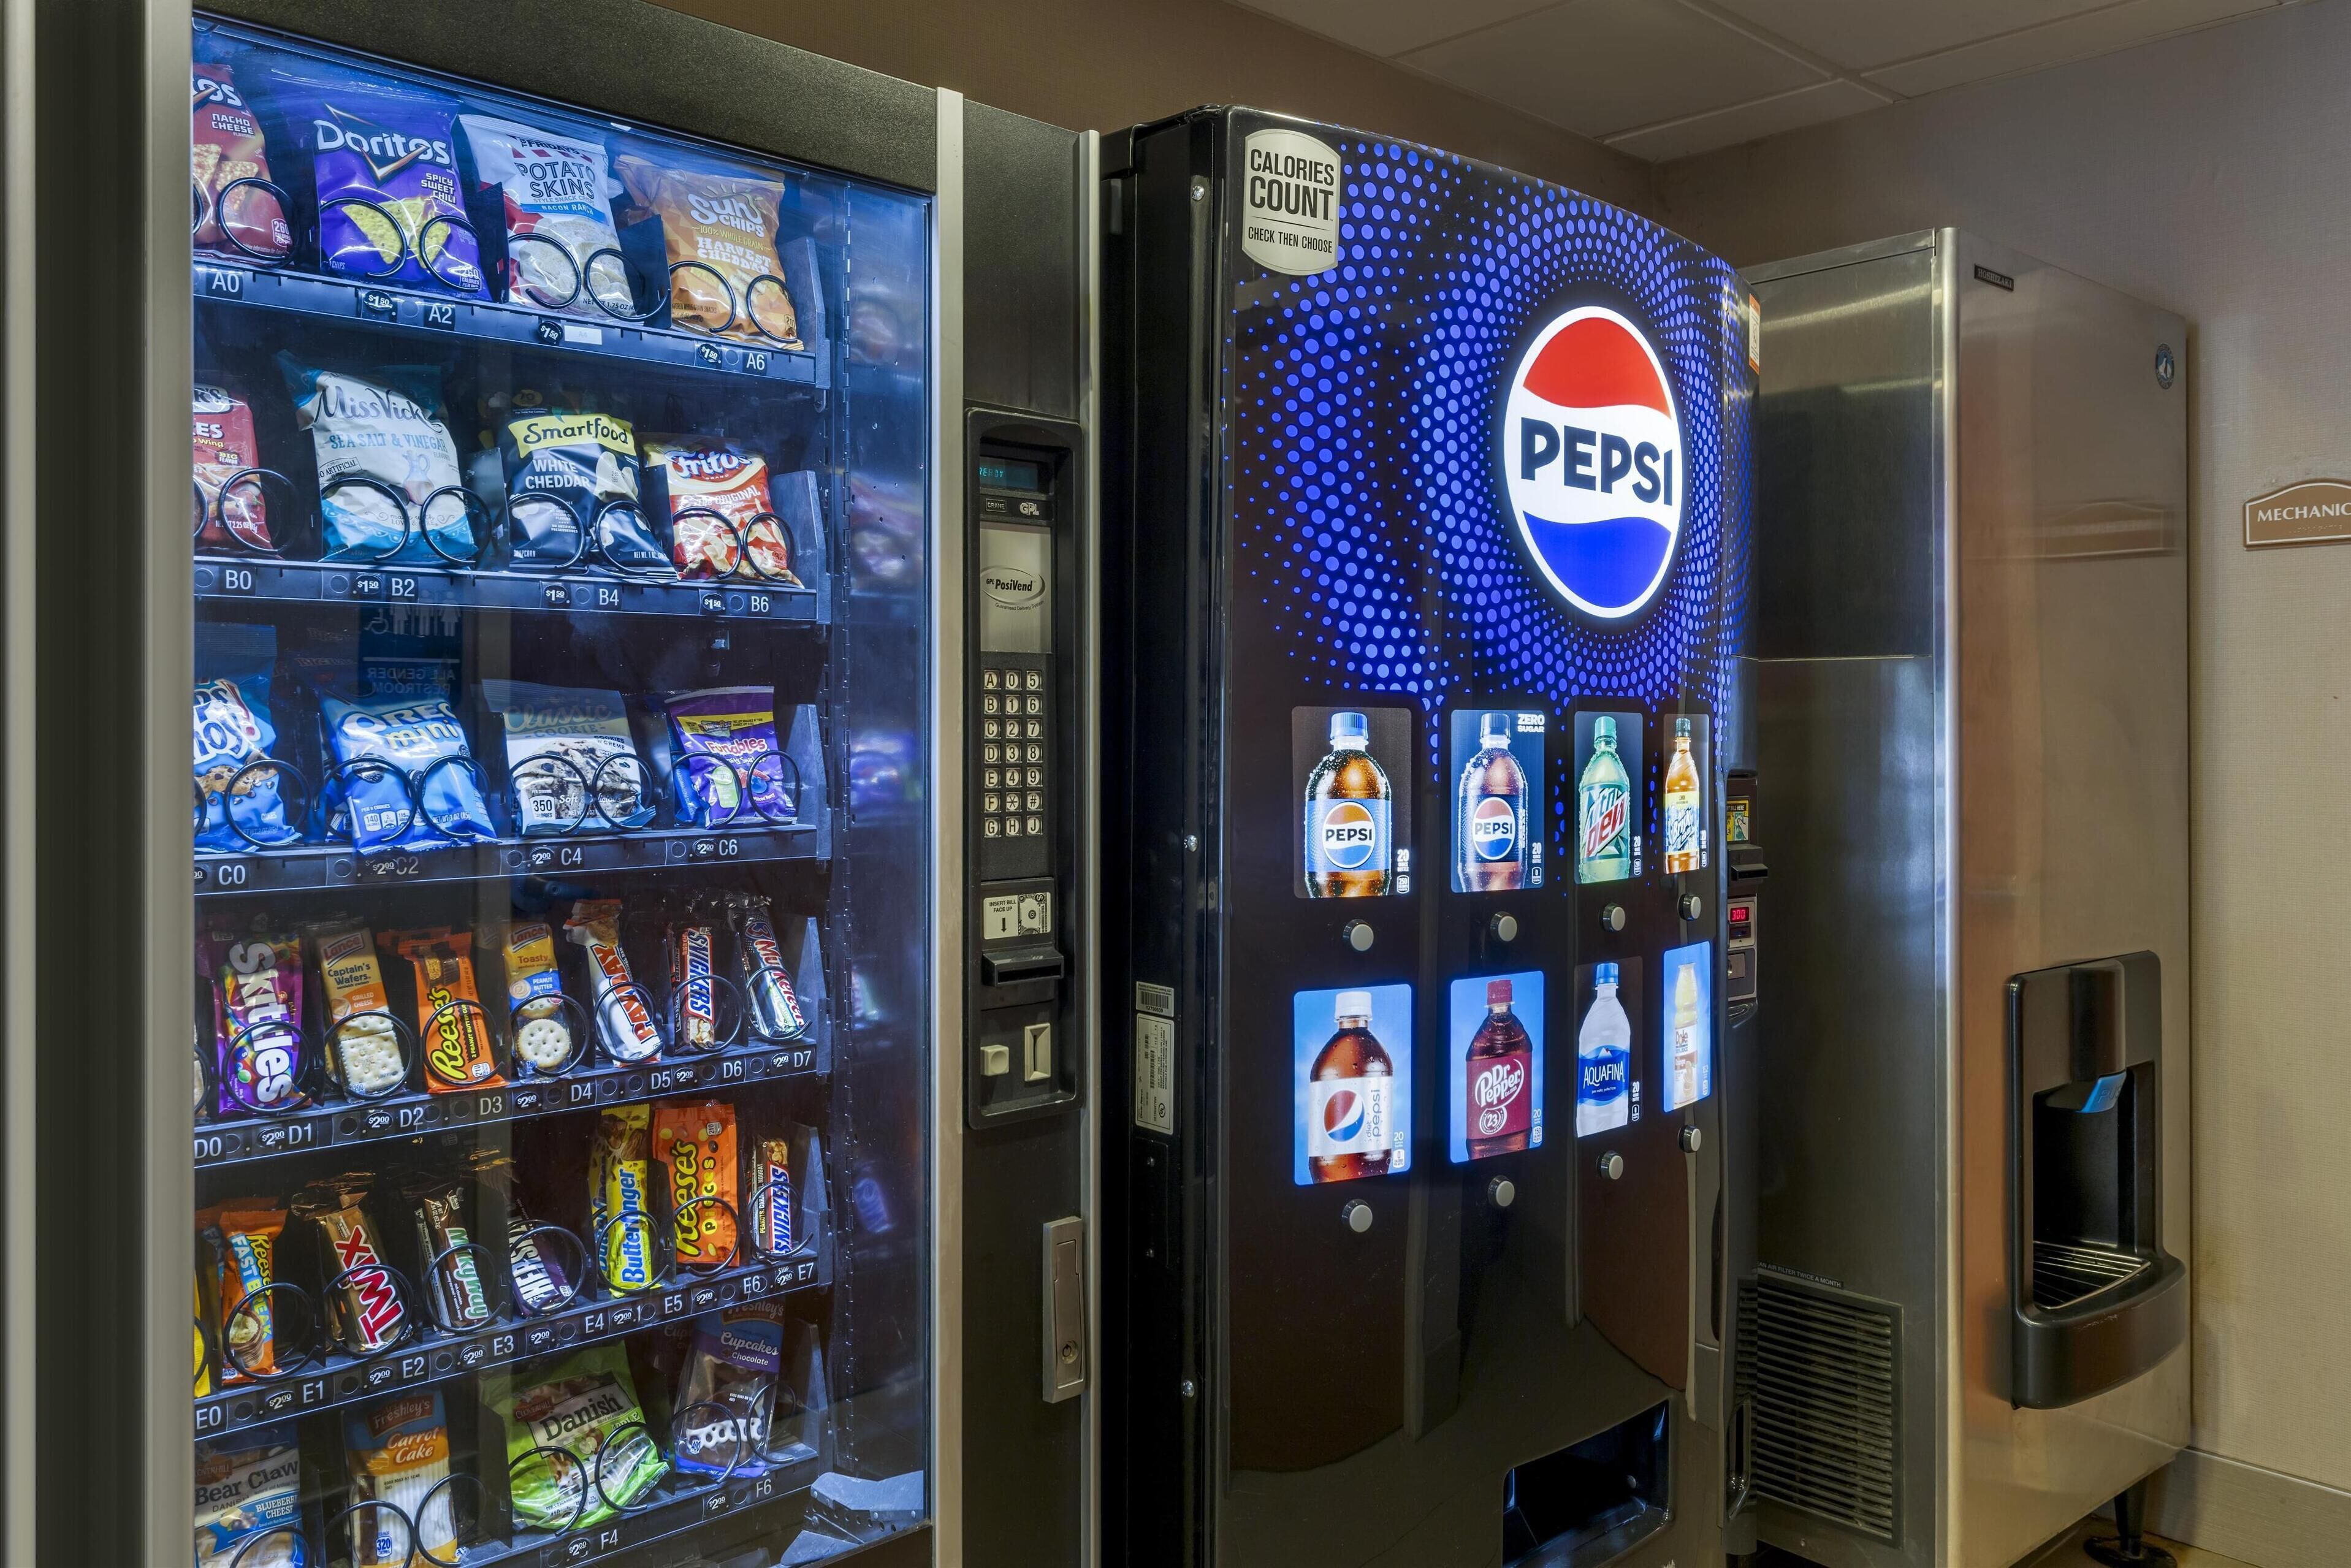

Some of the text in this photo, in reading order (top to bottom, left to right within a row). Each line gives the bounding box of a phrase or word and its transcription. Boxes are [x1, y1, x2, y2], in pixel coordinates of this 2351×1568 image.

[211, 121, 254, 135] CHEESE
[313, 120, 451, 166] Doritos
[514, 161, 596, 183] POTATO
[1251, 148, 1334, 186] CALORIES
[421, 180, 455, 194] SWEET
[426, 173, 453, 186] SPICY
[530, 178, 595, 200] SKINS
[433, 190, 456, 204] CHILI
[1249, 175, 1334, 221] COUNT
[571, 204, 594, 215] RANCH
[687, 191, 764, 226] Sun
[718, 215, 764, 238] CHIPS
[720, 230, 743, 245] WHOLE
[743, 237, 764, 251] GRAIN
[1248, 226, 1333, 254] CHECK THEN CHOOSE
[696, 237, 771, 267] HARVEST
[332, 261, 346, 270] CHIPS
[212, 273, 239, 293] A0
[1978, 268, 2012, 288] HOSHIZAKI
[429, 304, 452, 324] A2
[746, 354, 766, 371] A6
[523, 417, 628, 445] Smartfood
[329, 432, 449, 453] SEA SALT & VINEGAR
[532, 459, 578, 473] WHITE
[664, 451, 753, 479] Fritos
[1520, 416, 1673, 507] PEPSI
[525, 474, 590, 490] CHEDDAR
[1019, 502, 1040, 516] GPL
[225, 570, 252, 590] B0
[392, 578, 415, 597] B2
[995, 579, 1033, 592] PosiVend
[598, 588, 619, 606] B4
[751, 596, 769, 612] B6
[986, 674, 1036, 687] A 0 5
[987, 698, 1036, 711] B 1 6
[504, 704, 612, 732] Classic
[1517, 714, 1545, 726] ZERO
[386, 719, 459, 750] mini
[534, 724, 598, 737] COOKIE
[987, 722, 1036, 736] C 2 7
[1517, 725, 1545, 733] SUGAR
[593, 735, 625, 744] COOKIES
[603, 740, 625, 750] CREME
[705, 737, 768, 756] Funables
[988, 746, 1036, 760] D 3 8
[988, 771, 1037, 785] E 4 9
[533, 799, 552, 812] 350
[988, 795, 1037, 809] F #
[366, 815, 378, 824] 140
[988, 818, 1036, 834] G H J
[1474, 822, 1513, 835] PEPSI
[1325, 828, 1373, 842] PEPSI
[560, 847, 582, 866] C4
[718, 839, 737, 856] C6
[1397, 848, 1409, 862] 20
[1532, 842, 1542, 854] 20
[396, 856, 419, 875] C2
[218, 865, 245, 886] C0
[510, 925, 548, 945] Lance
[322, 934, 364, 961] Lance
[517, 954, 549, 964] Toasty
[327, 962, 371, 979] Captain's
[333, 972, 369, 987] Wafers
[687, 929, 711, 1018] SNICKERS
[352, 992, 375, 1002] GRILLED
[353, 999, 373, 1008] CHEESE
[590, 944, 658, 1045] PAYDAY
[229, 943, 293, 1103] Skittles
[427, 986, 468, 1080] Reese's
[794, 1050, 812, 1068] D7
[723, 1062, 742, 1078] D6
[1491, 1064, 1511, 1087] Dr
[1583, 1060, 1625, 1089] AQUAFINA
[650, 1071, 671, 1090] D5
[1475, 1069, 1521, 1108] Pepper
[1633, 1081, 1640, 1094] 20
[571, 1084, 592, 1102] D4
[480, 1097, 502, 1116] D3
[1370, 1089, 1382, 1137] pepsi
[1533, 1108, 1541, 1119] 20
[400, 1108, 424, 1127] D2
[1487, 1113, 1498, 1128] 23
[288, 1124, 312, 1144] D1
[1393, 1131, 1404, 1141] 20
[195, 1137, 221, 1159] D0
[669, 1137, 702, 1257] Reese's
[770, 1164, 792, 1255] SNICKERS
[798, 1262, 814, 1281] E7
[1777, 1266, 1796, 1276] FILTER
[1797, 1271, 1815, 1281] TWICE
[1819, 1277, 1842, 1288] MONTH
[333, 1225, 405, 1348] TWIX
[743, 1275, 761, 1294] E6
[665, 1295, 683, 1314] E5
[585, 1315, 604, 1333] E4
[493, 1338, 514, 1359] E3
[720, 1330, 780, 1357] Cupcakes
[403, 1357, 425, 1379] E2
[731, 1351, 769, 1366] Chocolate
[303, 1381, 324, 1403] E1
[196, 1408, 221, 1430] E0
[372, 1399, 430, 1430] Freshley's
[539, 1394, 623, 1442] Danish
[386, 1427, 440, 1450] Carrot
[691, 1441, 701, 1452] 400
[395, 1444, 433, 1464] Cake
[195, 1481, 242, 1507] Bear
[248, 1461, 299, 1490] Claw
[755, 1480, 771, 1498] F6
[376, 1539, 391, 1550] 320
[601, 1532, 619, 1550] F4
